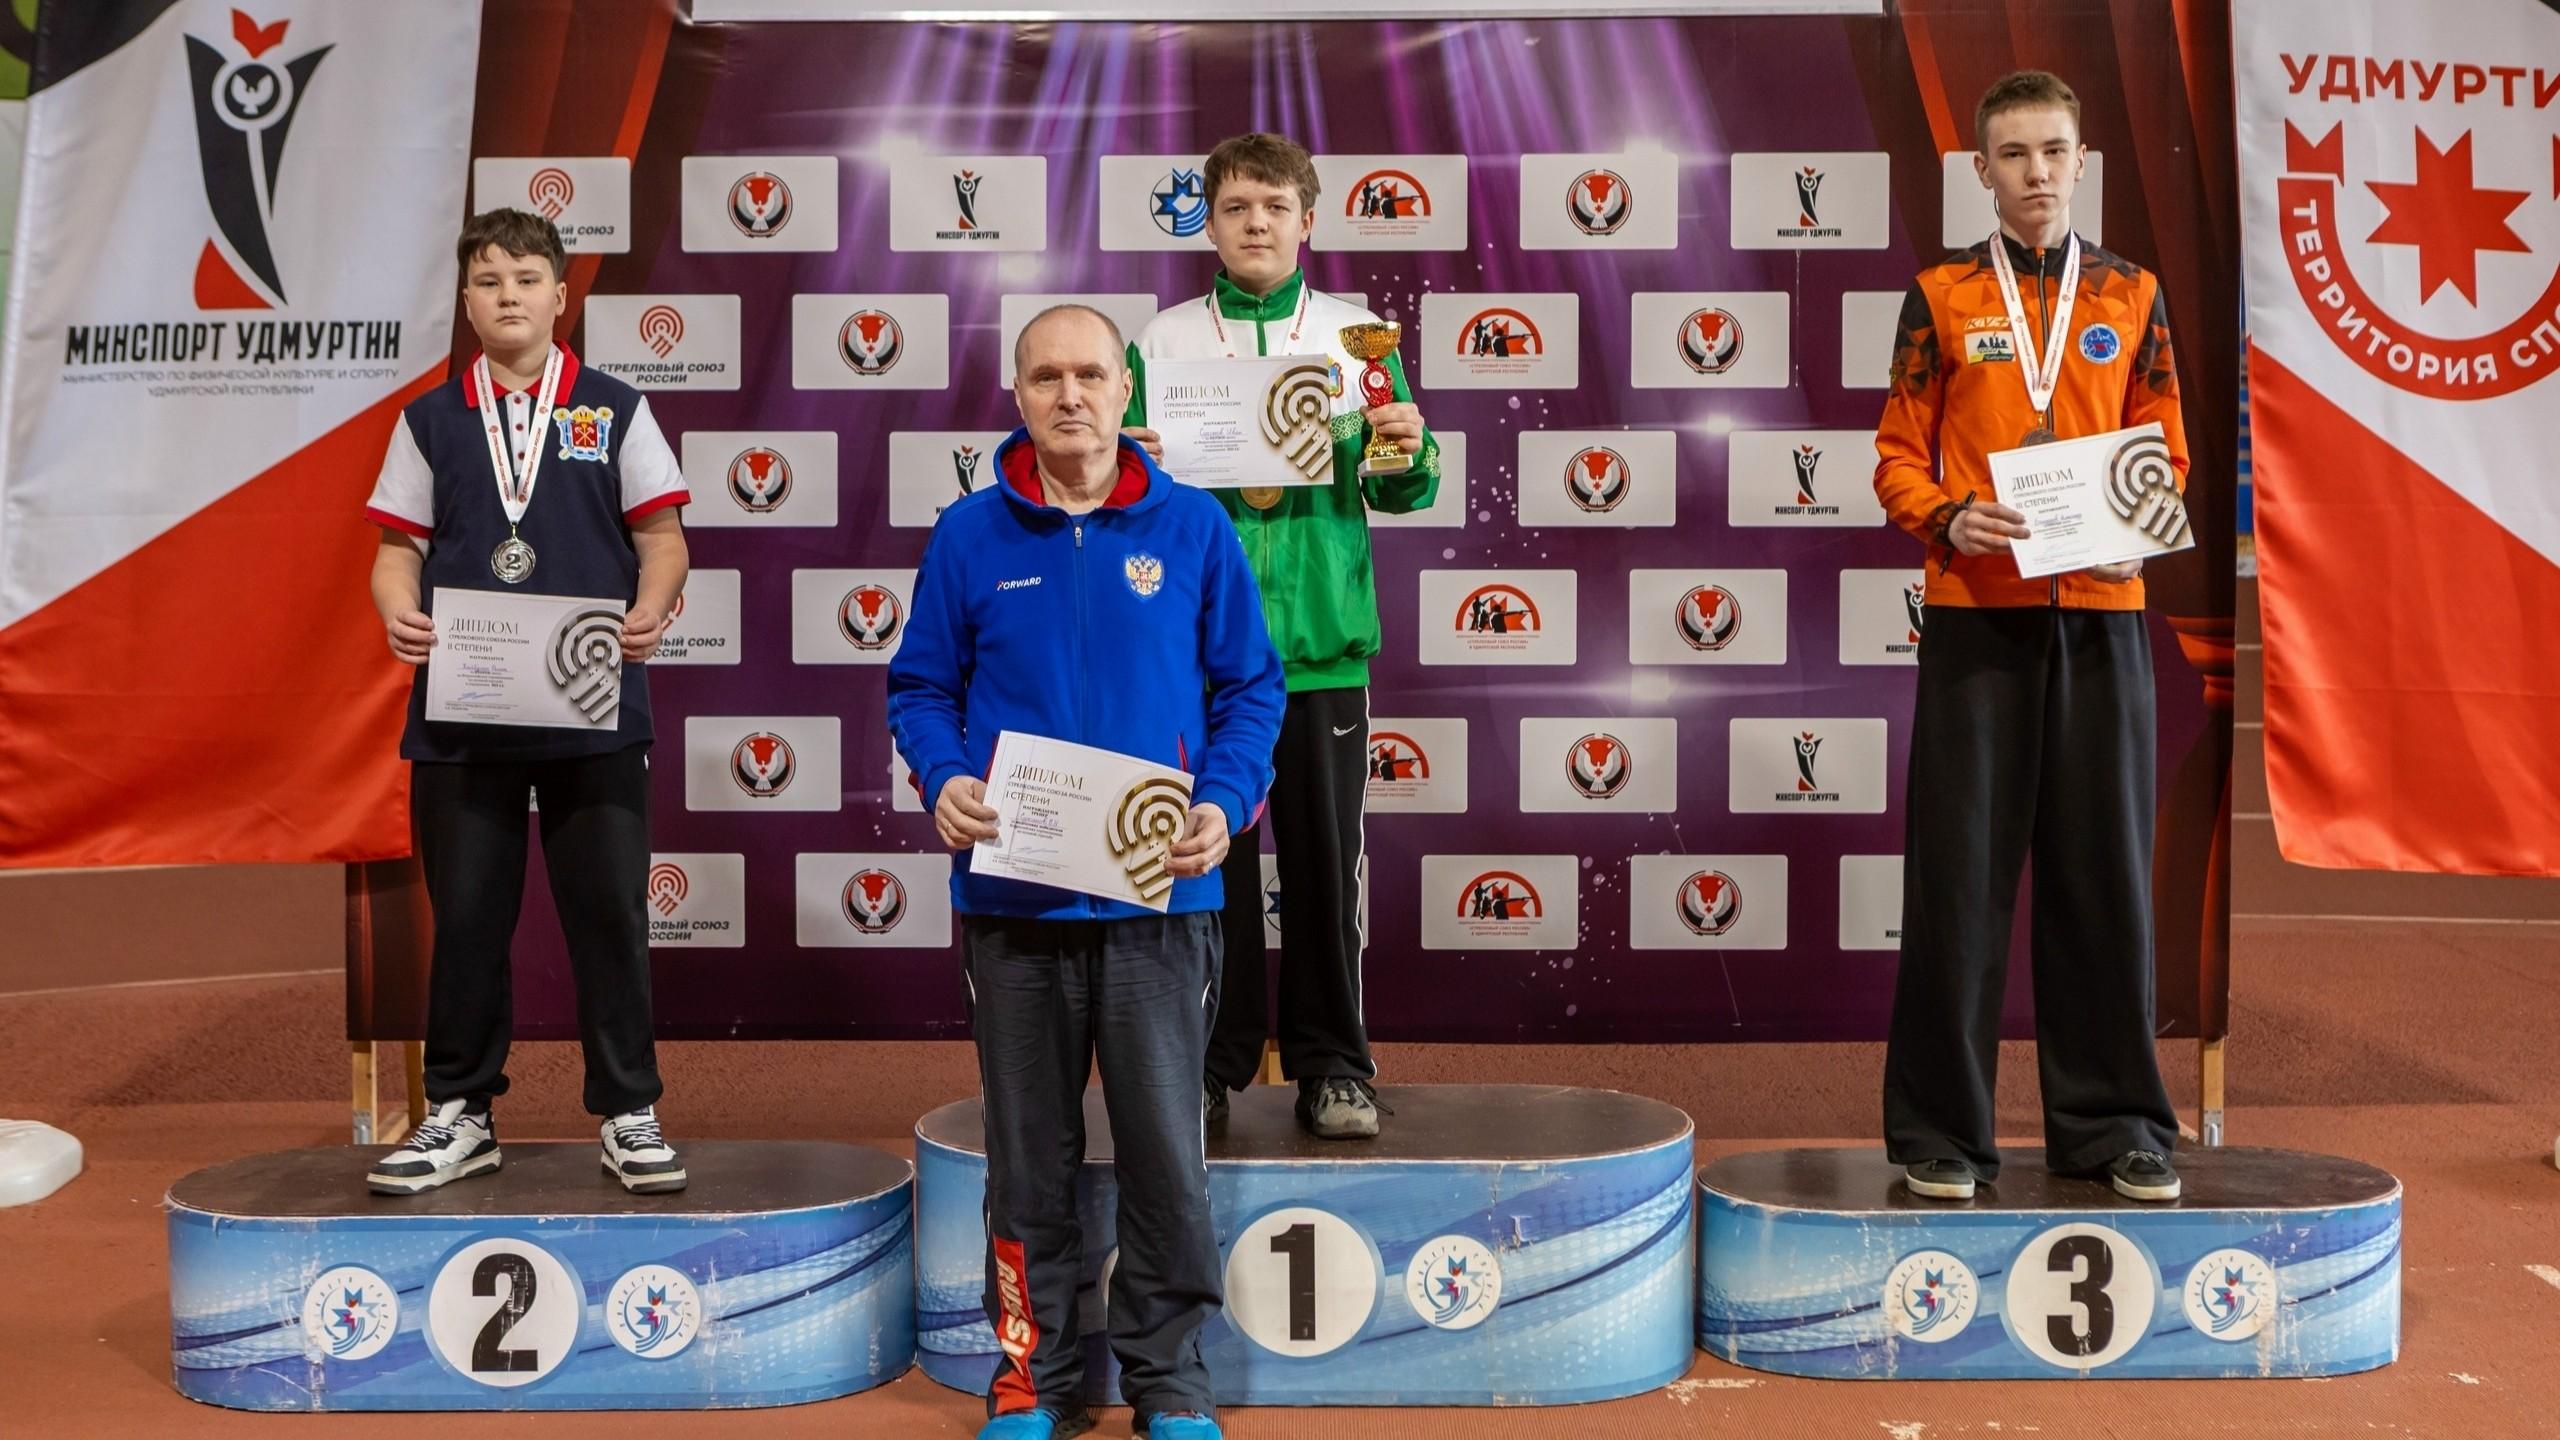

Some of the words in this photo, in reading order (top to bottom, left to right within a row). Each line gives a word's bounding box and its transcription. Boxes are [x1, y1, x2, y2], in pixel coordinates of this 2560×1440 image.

[577, 225, 615, 235] СОЮЗ
[2292, 198, 2499, 386] ТЕРРИТОРИЯ
[2510, 302, 2560, 368] СП
[64, 322, 228, 365] МИНСПОРТ
[235, 320, 403, 365] УДМУРТИИ
[338, 368, 348, 379] И
[350, 368, 399, 380] СПОРТУ
[598, 361, 685, 373] СТРЕЛКОВЫЙ
[687, 363, 726, 373] СОЮЗ
[636, 374, 688, 384] РОССИИ
[1163, 385, 1230, 401] ДИПЛОМ
[1169, 410, 1206, 419] СТЕПЕНИ
[2012, 467, 2074, 493] ДИПЛОМ
[2024, 496, 2059, 508] СТЕПЕНИ
[505, 552, 522, 570] 2
[996, 576, 1042, 591] FORWARD
[448, 617, 520, 635] ДИПЛОМ
[454, 643, 493, 653] СТЕПЕНИ
[687, 637, 726, 647] СОЮЗ
[653, 648, 688, 658] ССИИ
[1008, 763, 1083, 791] ДИПЛОМ
[1010, 791, 1051, 806] СТЕПЕНИ
[691, 920, 730, 930] СОЮЗ
[648, 931, 692, 941] ОССИИ
[1270, 1223, 1317, 1342] 1
[2045, 1234, 2114, 1357] 3
[471, 1252, 539, 1373] 2
